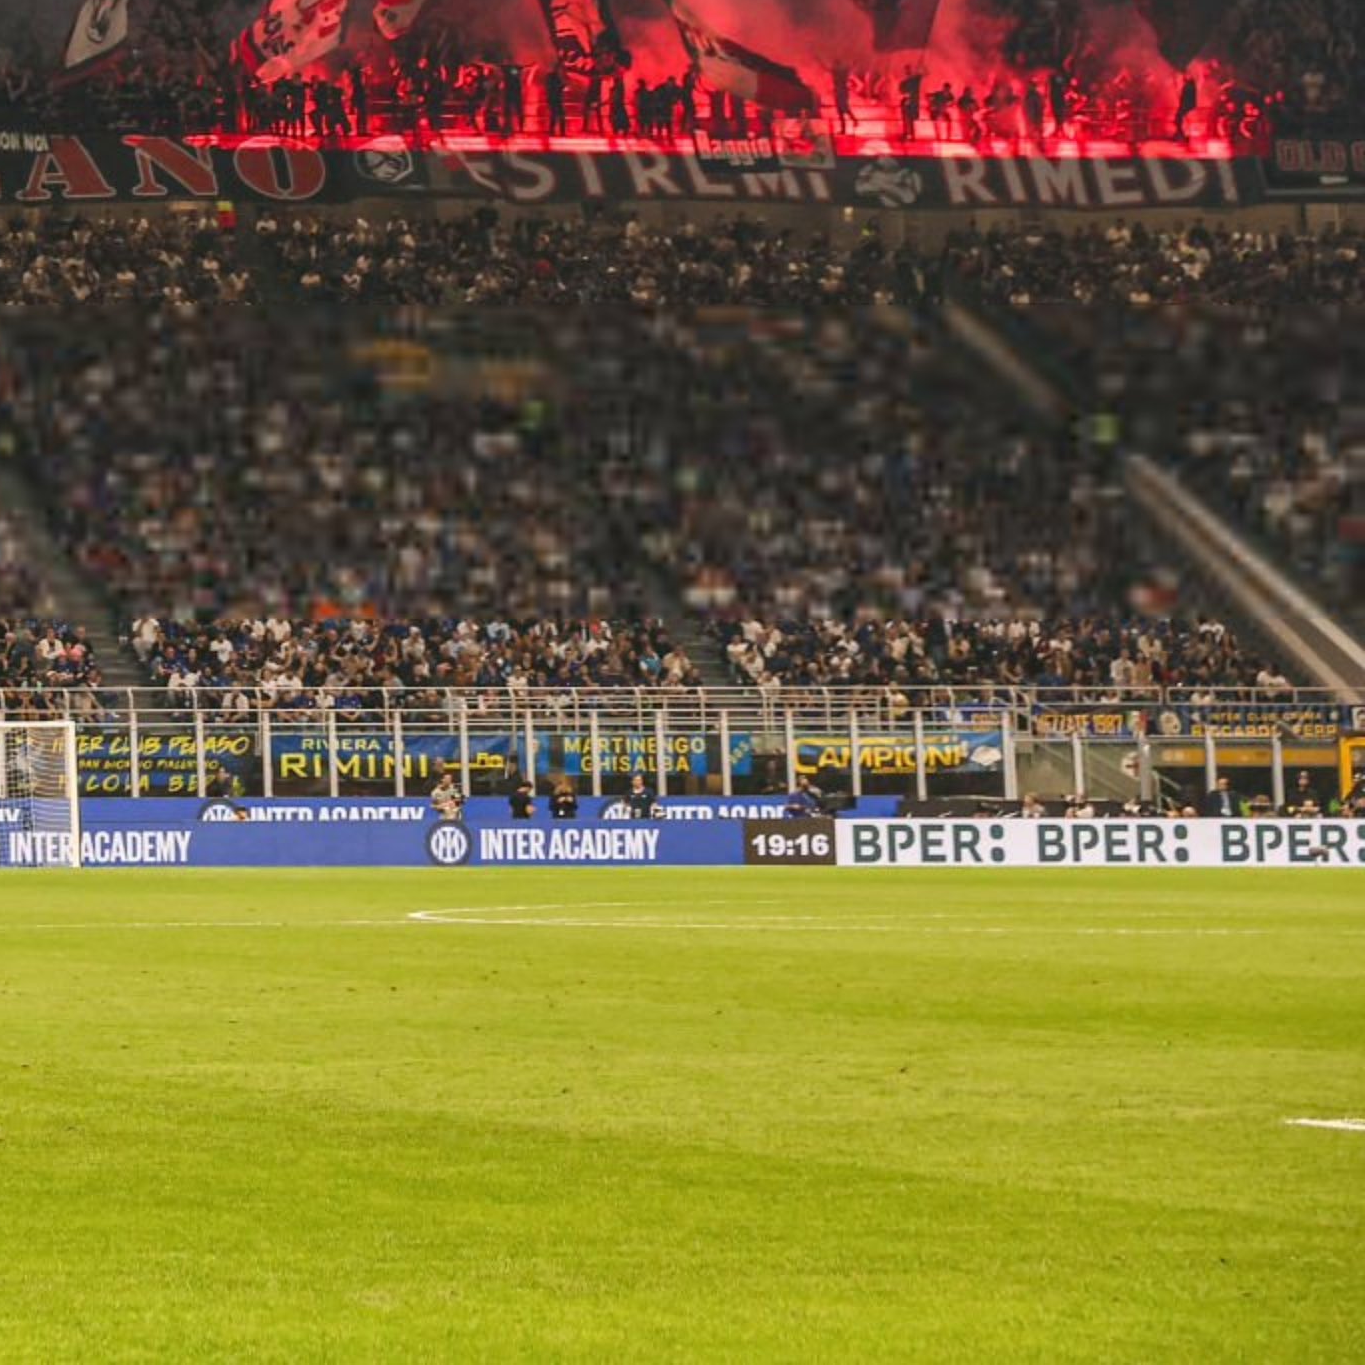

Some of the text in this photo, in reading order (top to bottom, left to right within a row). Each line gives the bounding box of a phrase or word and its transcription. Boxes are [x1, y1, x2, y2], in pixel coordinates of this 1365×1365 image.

[931, 140, 1241, 201] RIMEDI
[301, 738, 382, 751] RIVIERA
[564, 736, 706, 754] MARTINENGO
[280, 752, 429, 778] RIMINI
[581, 755, 690, 773] GHISALBA
[9, 830, 191, 862] INTER ACADEMY
[480, 828, 660, 860] INTER ACADEMY
[751, 834, 830, 857] 19:16
